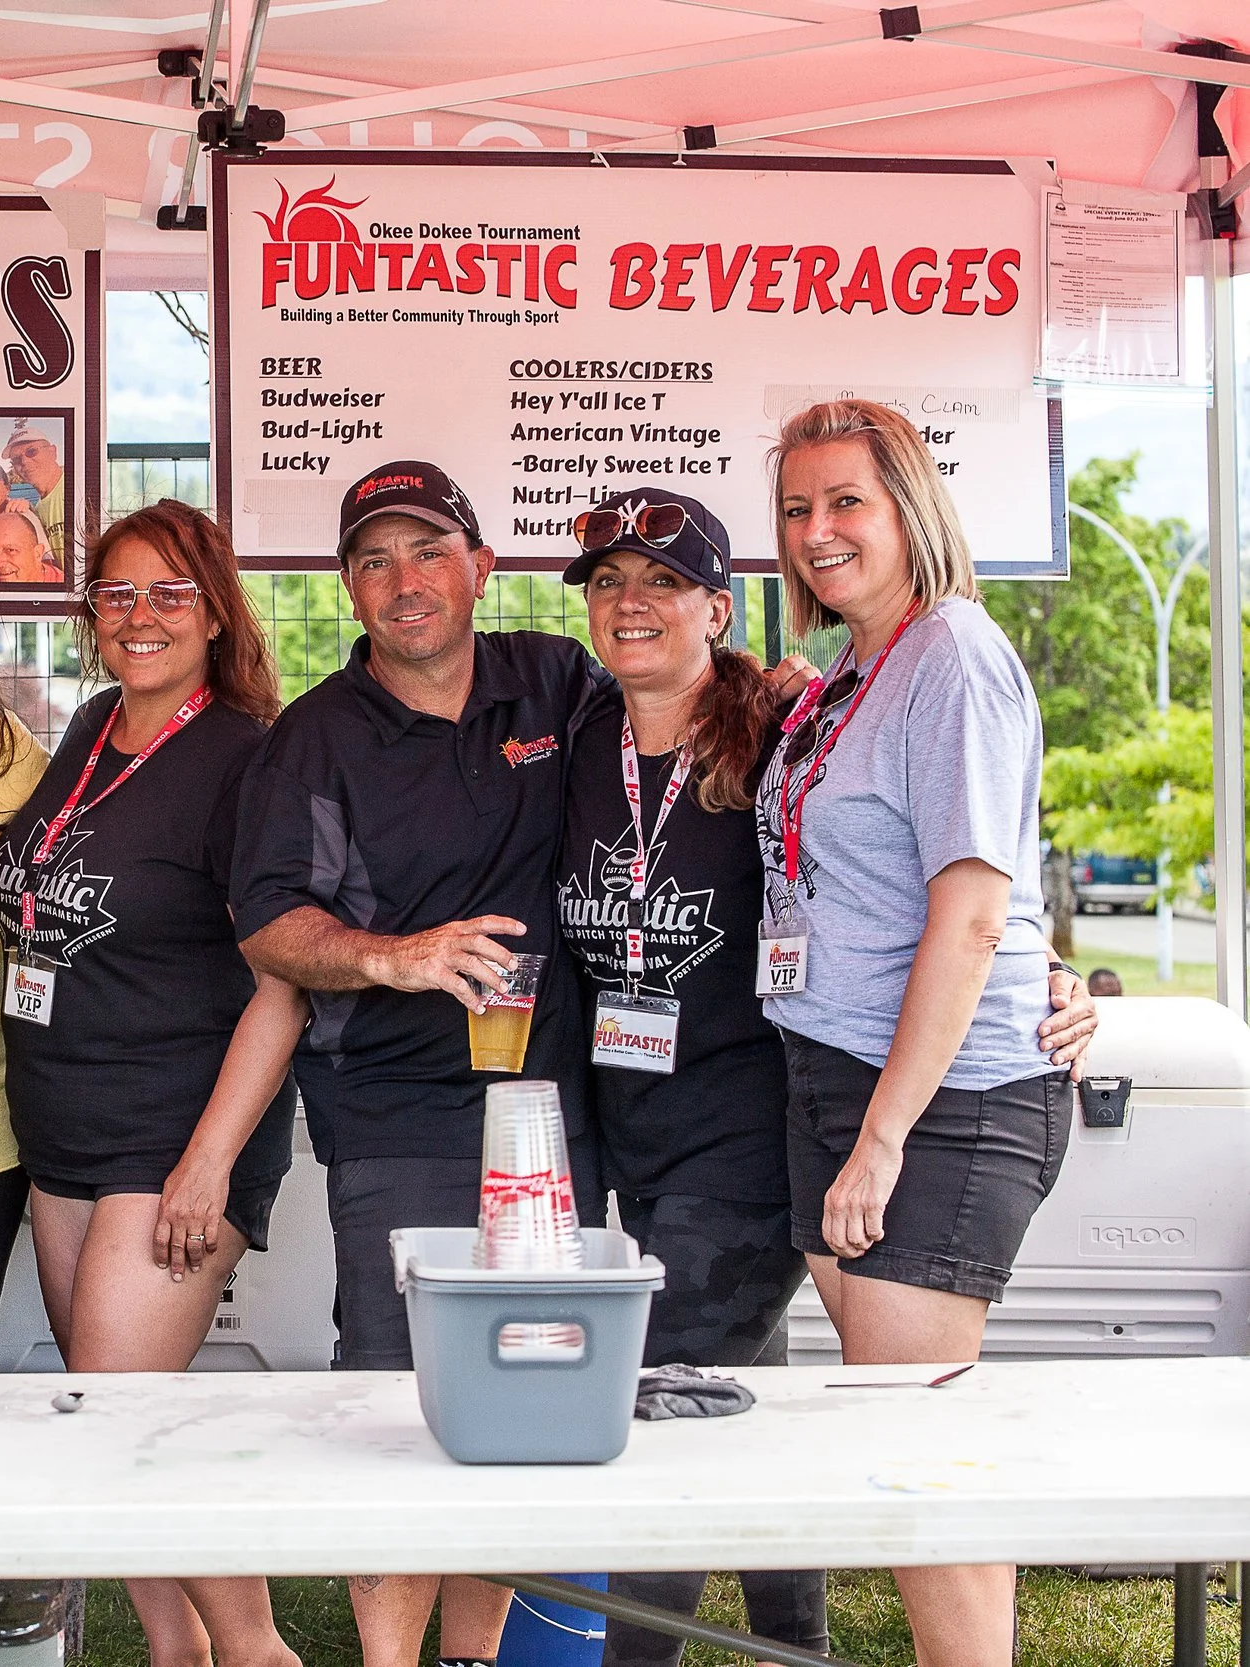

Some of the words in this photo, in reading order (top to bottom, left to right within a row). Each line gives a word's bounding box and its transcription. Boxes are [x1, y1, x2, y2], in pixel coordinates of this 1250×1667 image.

[369, 223, 413, 239] Okee
[419, 223, 472, 239] Dokee
[478, 223, 580, 240] Tournament
[262, 242, 577, 309] FUNTASTIC
[609, 241, 1021, 316] BEVERAGES
[280, 308, 332, 325] Building
[336, 312, 344, 322] a
[348, 309, 388, 322] Better
[392, 309, 464, 325] Community
[468, 309, 521, 325] Through
[524, 310, 559, 326] Sport
[260, 357, 322, 376] BEER
[509, 359, 713, 380] COOLERS/CIDERS
[261, 387, 385, 407] Budweiser
[511, 391, 554, 414] Hey
[559, 391, 608, 411] Y'all
[614, 392, 646, 411] Ice
[652, 392, 666, 411] T
[261, 419, 383, 444] Bud-Light
[511, 422, 623, 442] American
[630, 423, 721, 448] Vintage
[261, 451, 330, 475] Lucky
[511, 454, 598, 478] -Barely
[604, 455, 673, 475] Sweet
[680, 456, 712, 475] Ice
[717, 456, 732, 475] T
[146, 730, 170, 754] CANADA
[606, 866, 618, 874] EST
[36, 902, 90, 926] URNAMENT
[67, 942, 84, 957] PORT
[85, 926, 116, 945] ALBERNI
[576, 929, 605, 940] PITCH
[609, 930, 699, 946] TONAMENT
[672, 964, 692, 983] PORT
[693, 940, 725, 967] ALBERNI
[771, 968, 797, 986] VIP
[17, 993, 42, 1012] VIP
[487, 995, 533, 1009] Budweiser
[594, 1030, 672, 1057] FUNTASTIC
[1091, 1226, 1186, 1249] IGLOO
